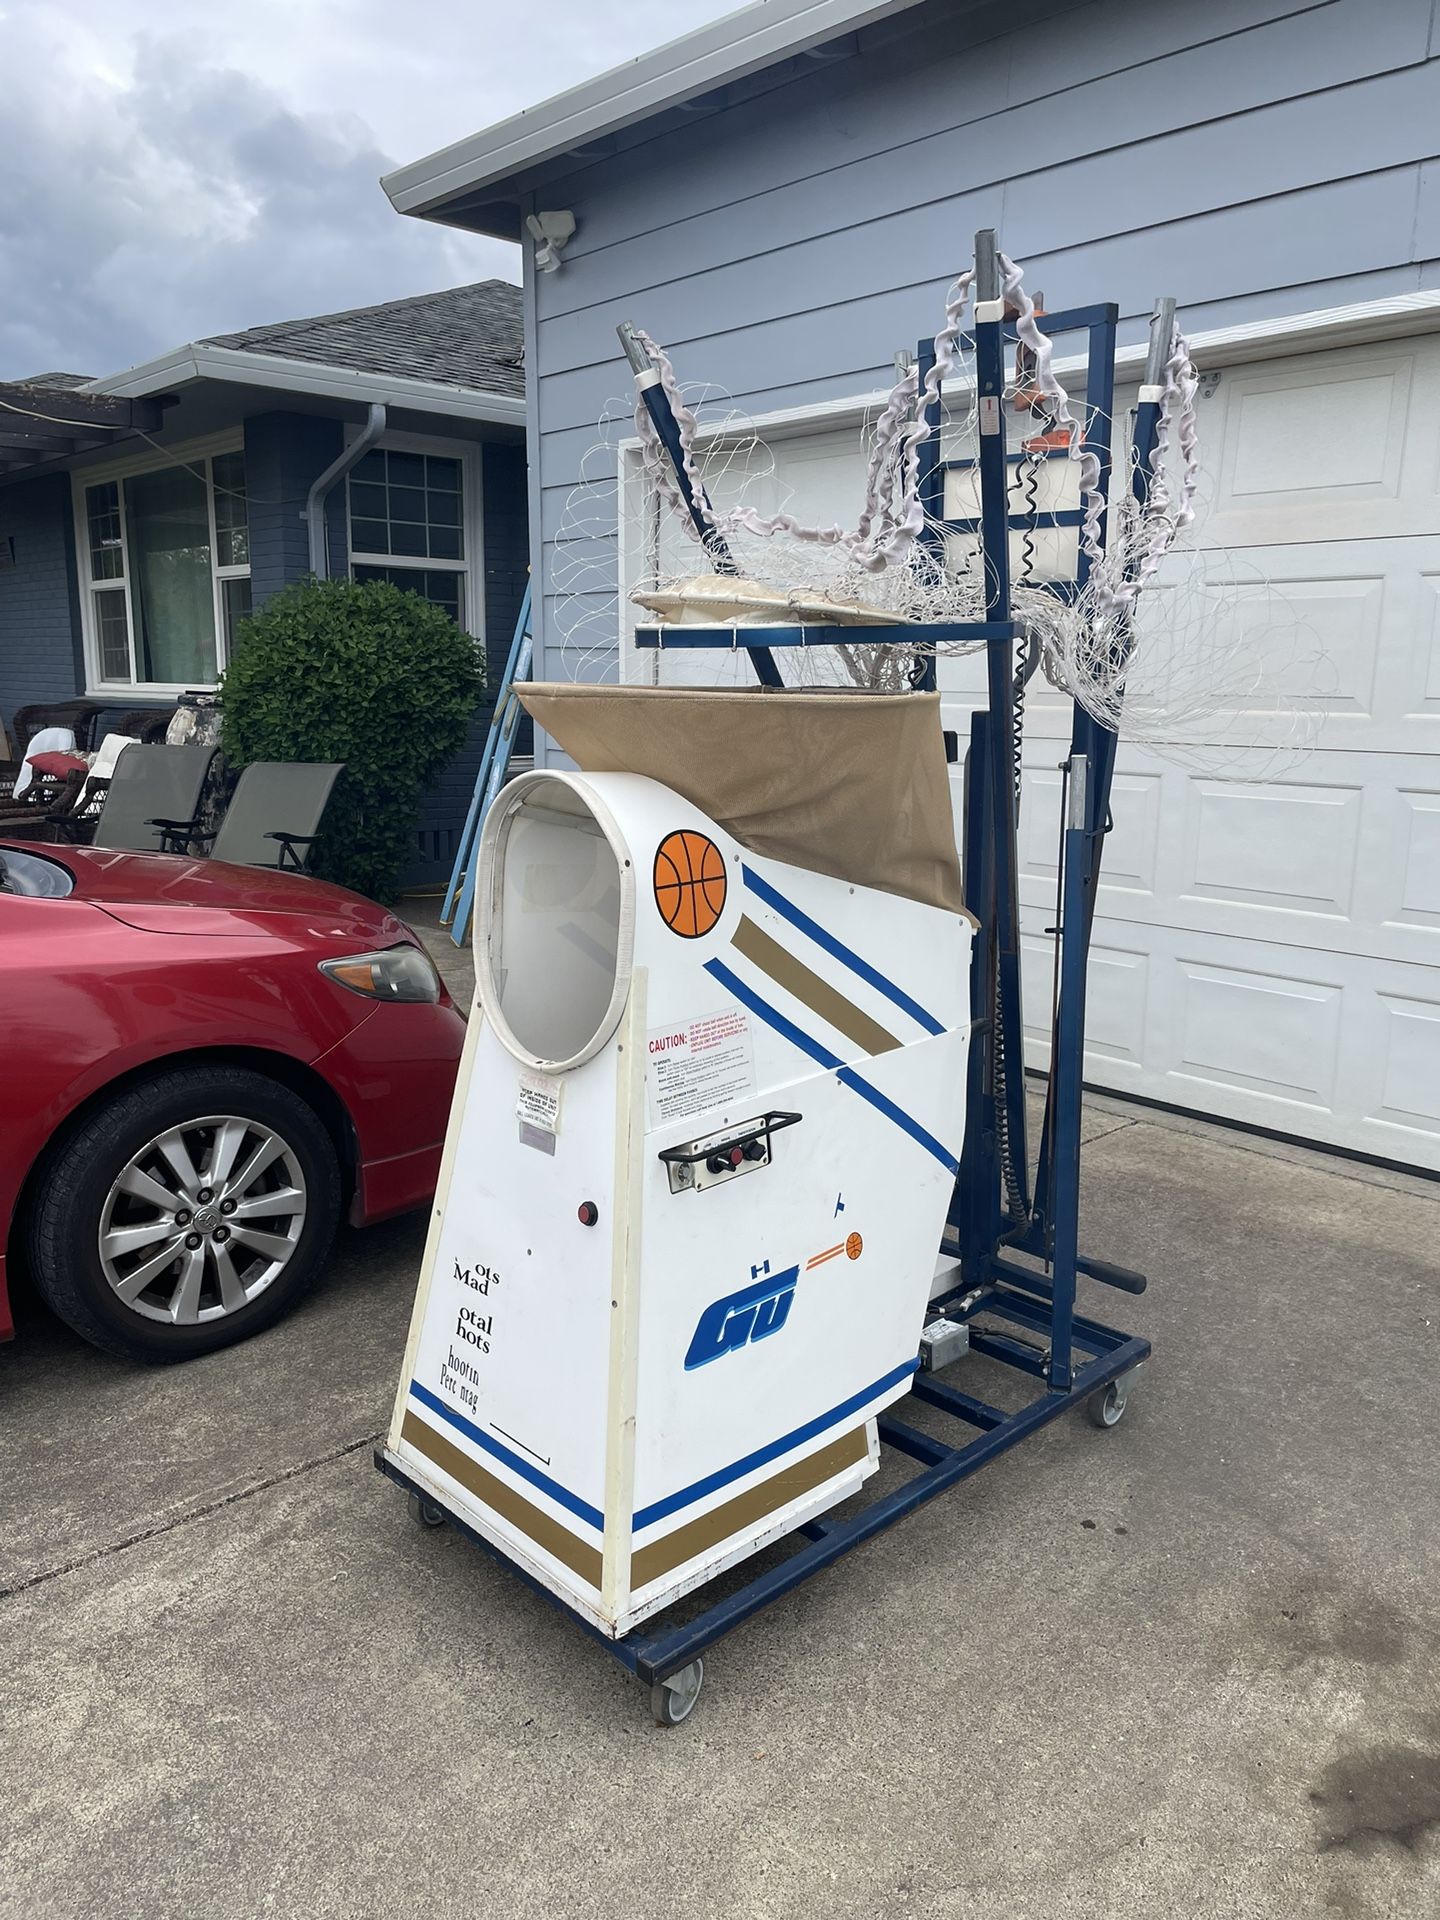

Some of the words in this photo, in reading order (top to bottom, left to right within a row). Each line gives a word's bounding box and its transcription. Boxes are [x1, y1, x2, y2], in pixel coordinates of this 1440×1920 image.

[649, 1033, 687, 1053] CAUTION:
[453, 1262, 489, 1297] Mad
[456, 1317, 490, 1354] hots
[459, 1307, 493, 1336] otal
